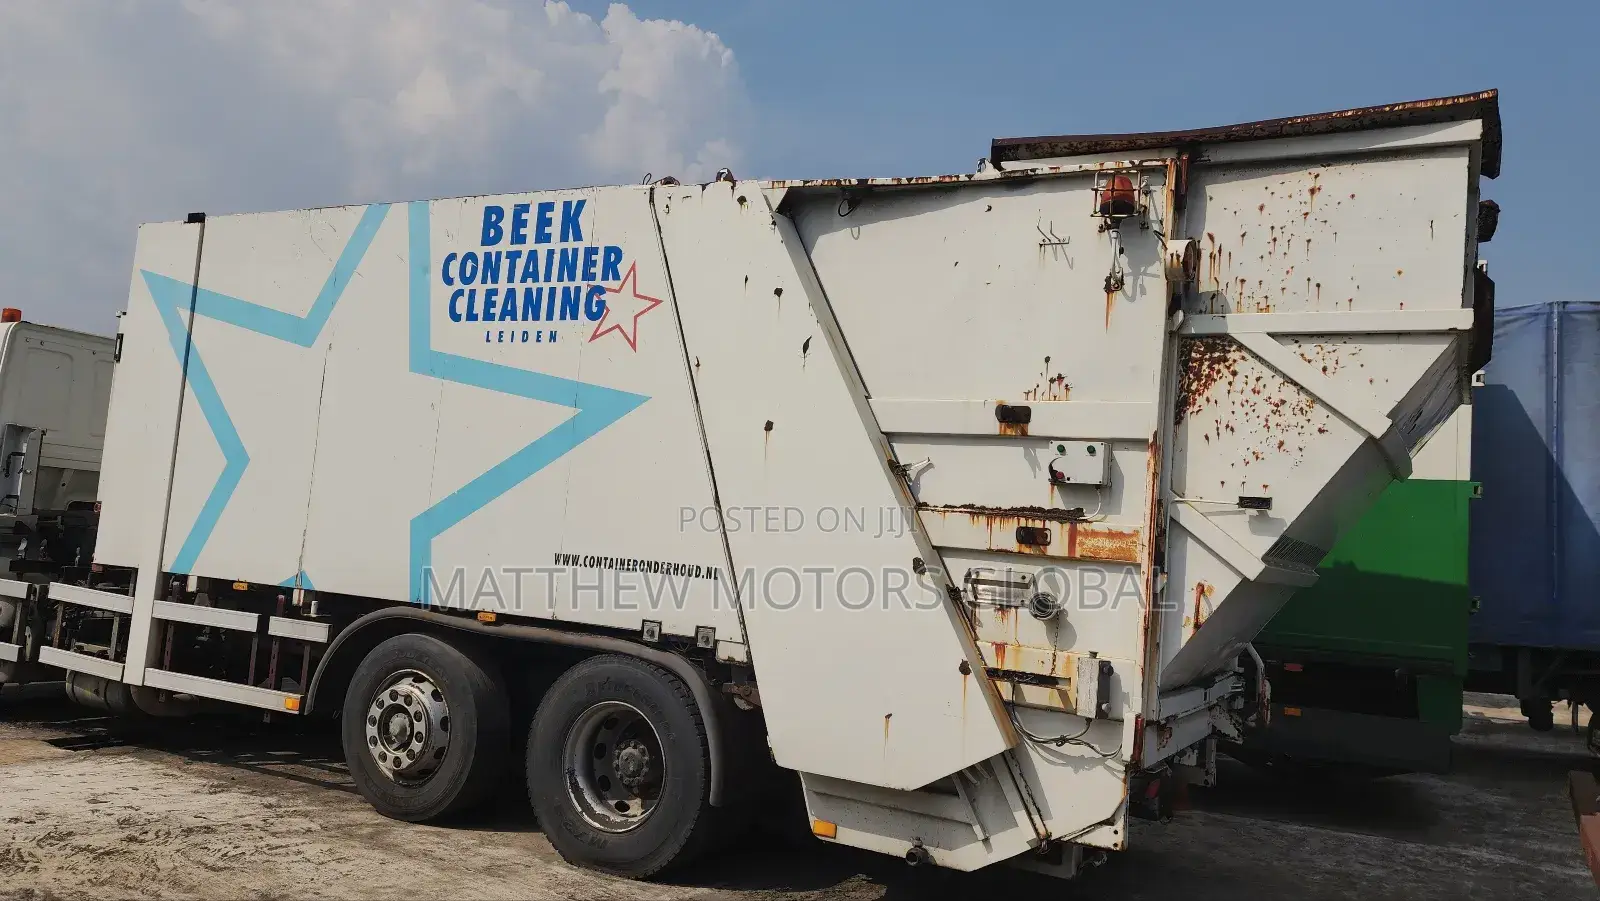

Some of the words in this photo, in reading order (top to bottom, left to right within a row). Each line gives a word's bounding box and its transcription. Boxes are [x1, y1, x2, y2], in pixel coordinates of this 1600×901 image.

[481, 199, 587, 246] BEEK
[442, 245, 623, 286] CONTAINER
[449, 285, 607, 322] CLEANING
[486, 330, 557, 343] LEIDEN
[554, 552, 719, 581] WWW.CONTAINERONDERHOUD.NL
